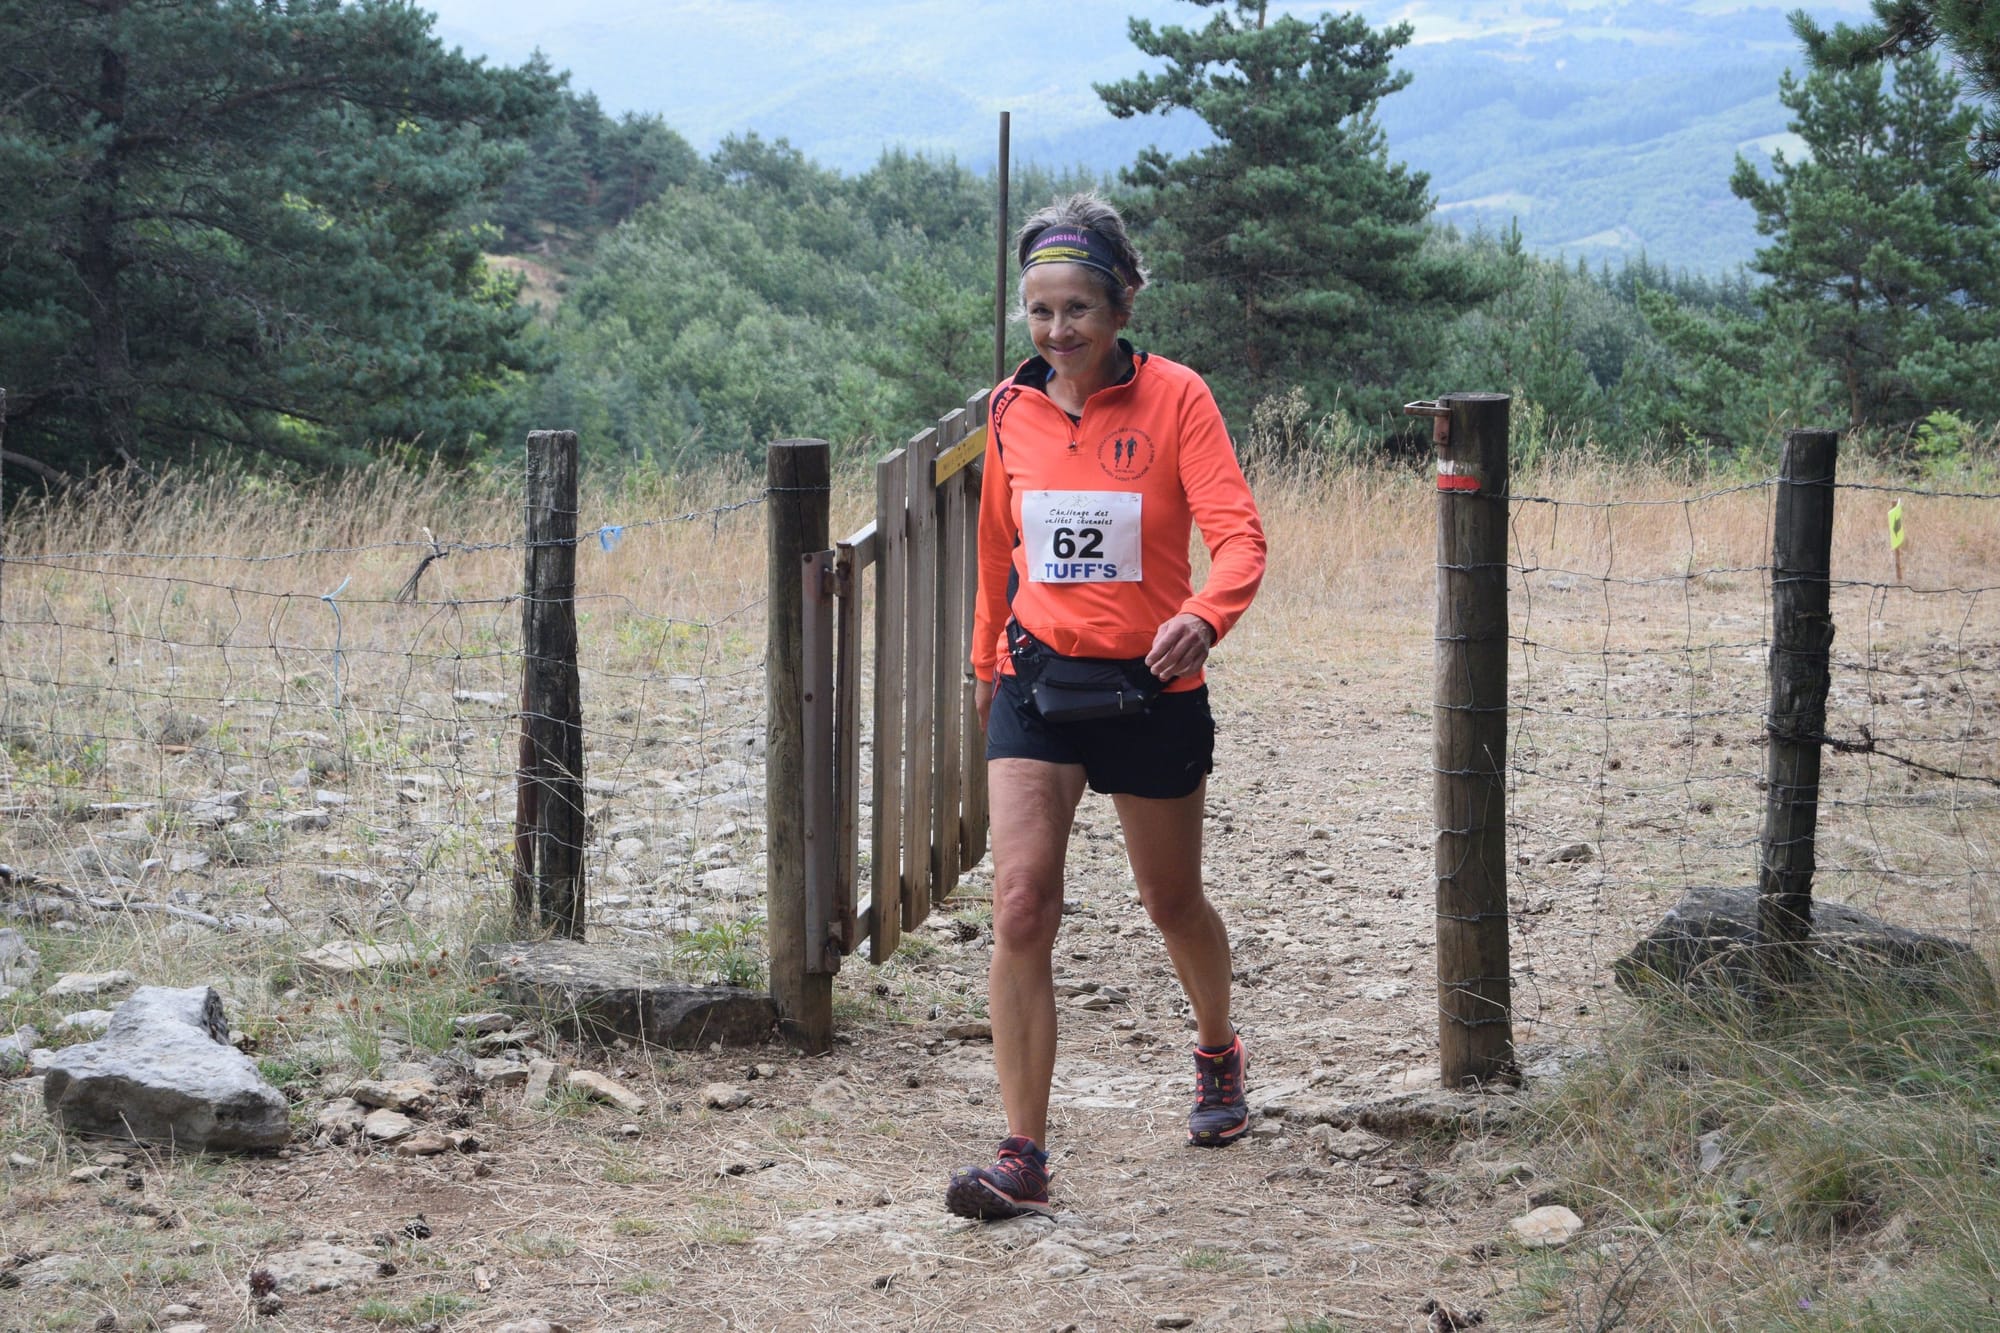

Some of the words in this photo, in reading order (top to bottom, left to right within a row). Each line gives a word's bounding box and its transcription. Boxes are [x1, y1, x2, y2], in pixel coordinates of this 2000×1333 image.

[1049, 508, 1090, 519] Challenge
[1053, 527, 1104, 559] 62
[1045, 563, 1118, 579] TUFF'S
